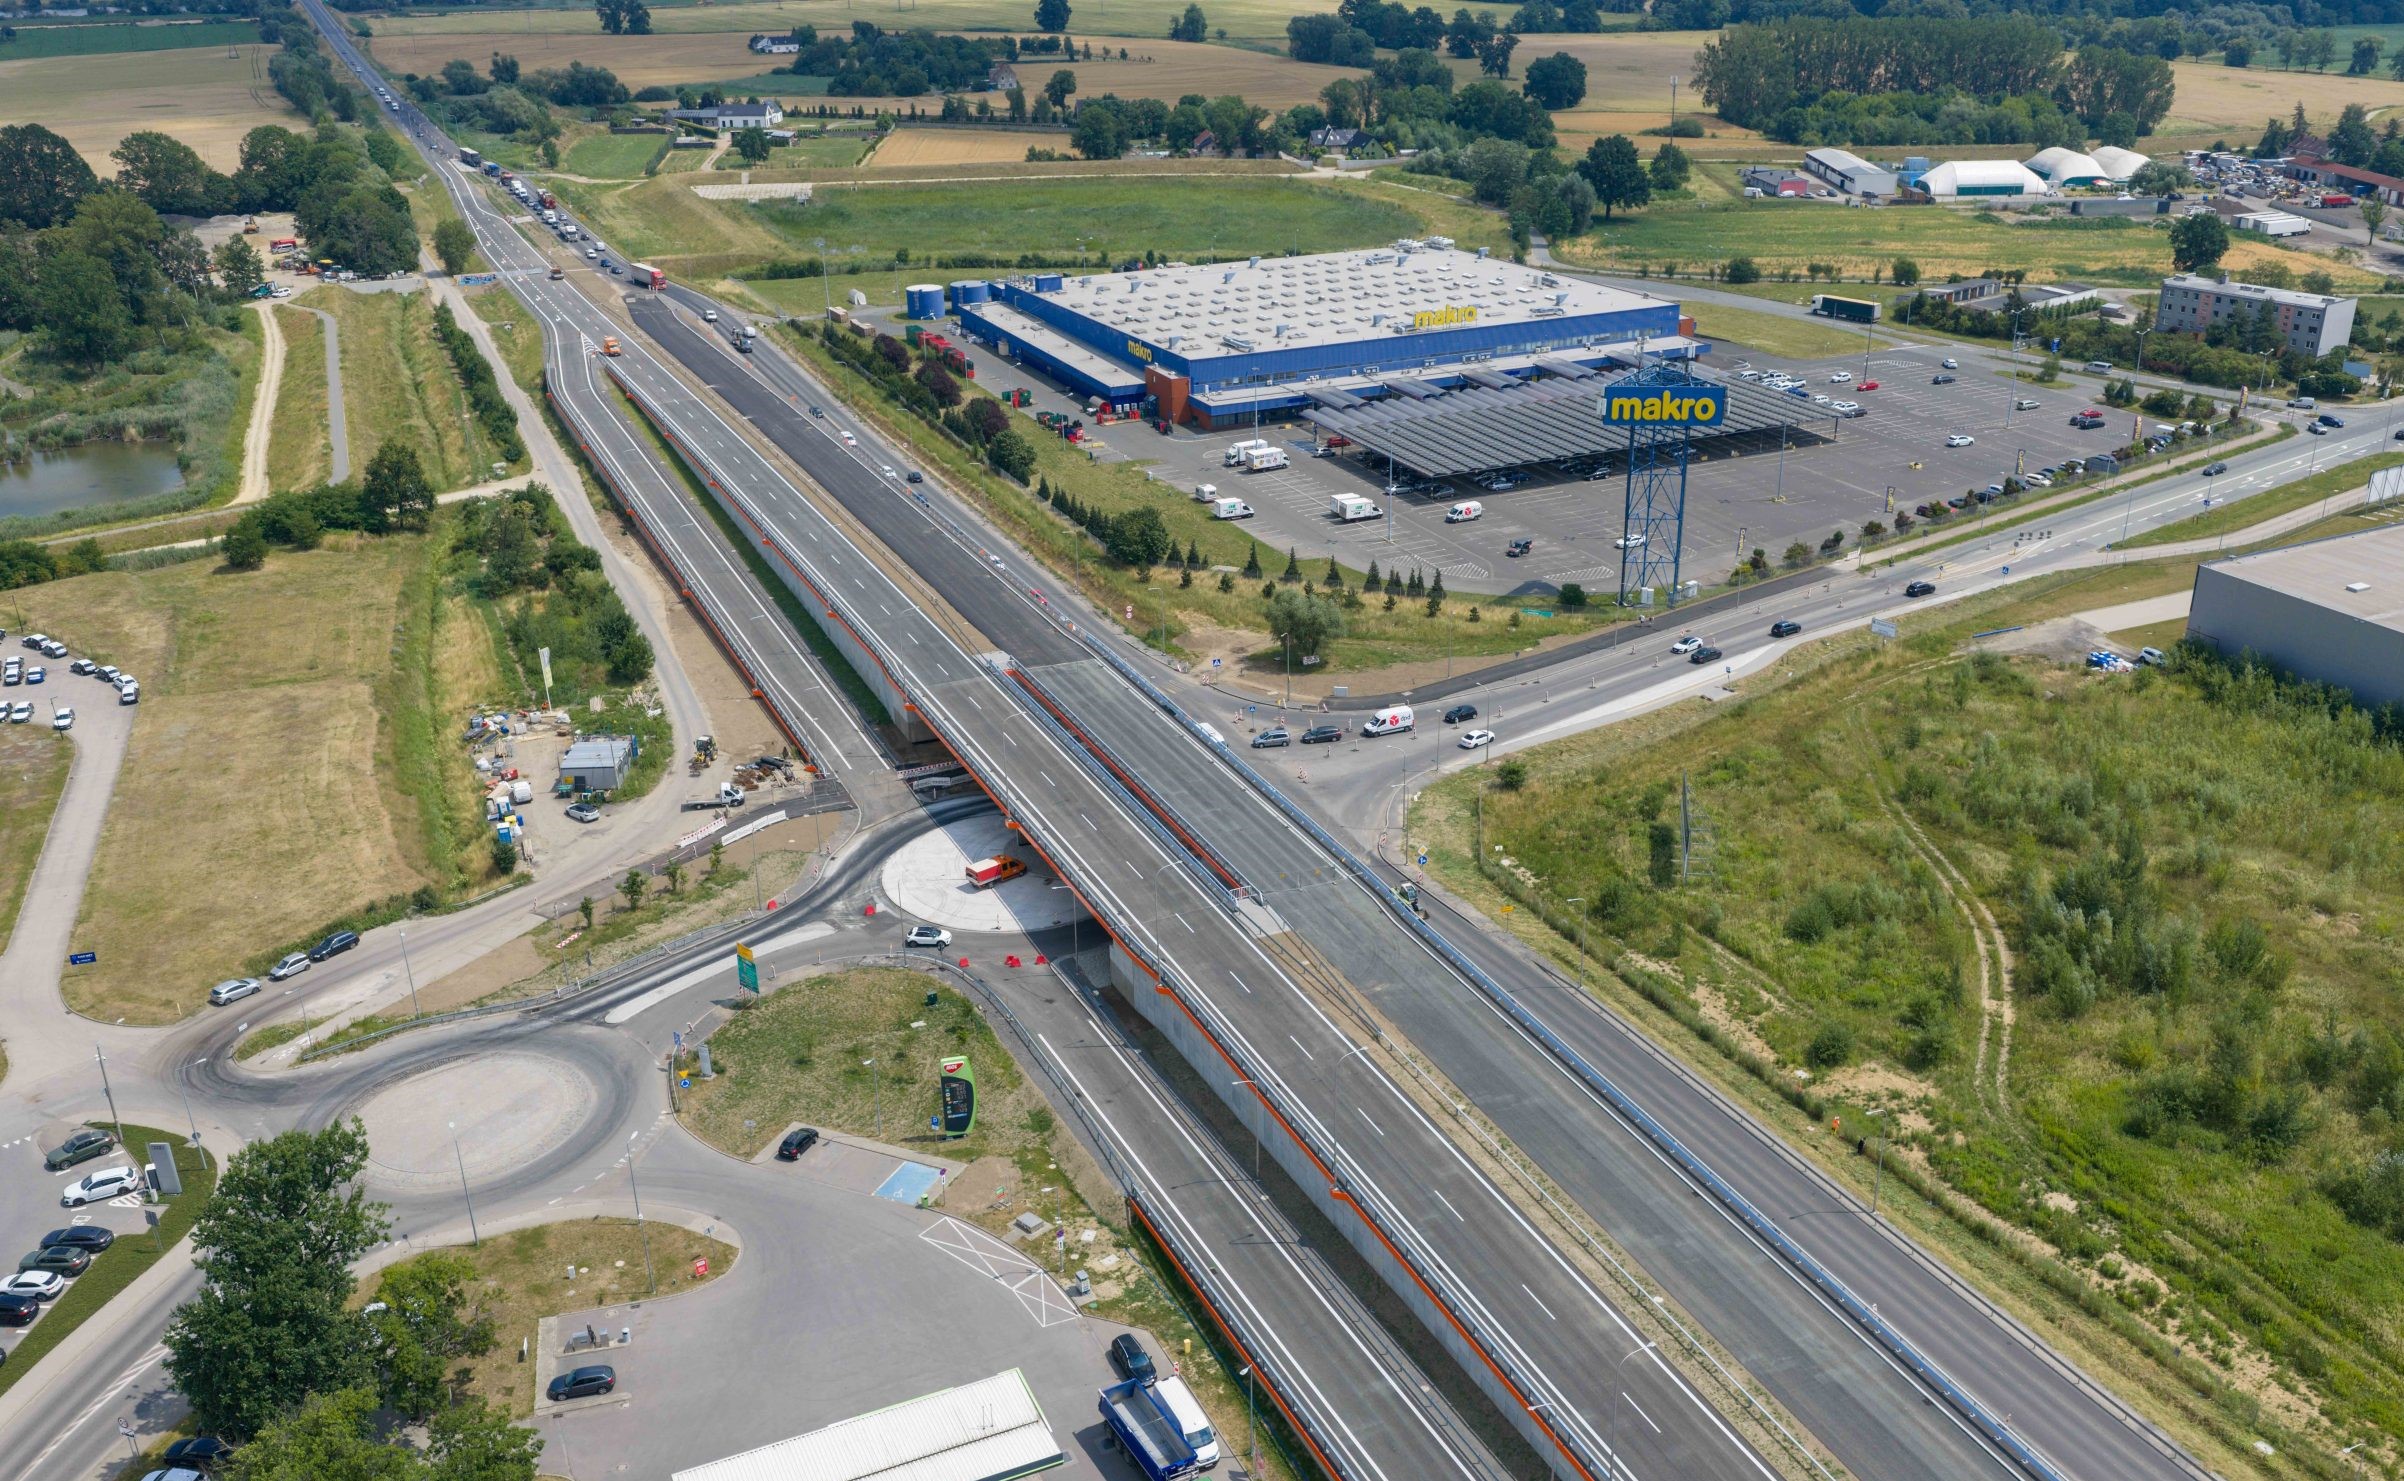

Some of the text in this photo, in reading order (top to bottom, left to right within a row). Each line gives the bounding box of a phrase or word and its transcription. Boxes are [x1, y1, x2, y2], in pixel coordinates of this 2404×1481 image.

[1414, 304, 1477, 329] makro
[1128, 340, 1152, 362] makro
[1611, 390, 1716, 421] makro
[1401, 714, 1411, 722] dpd
